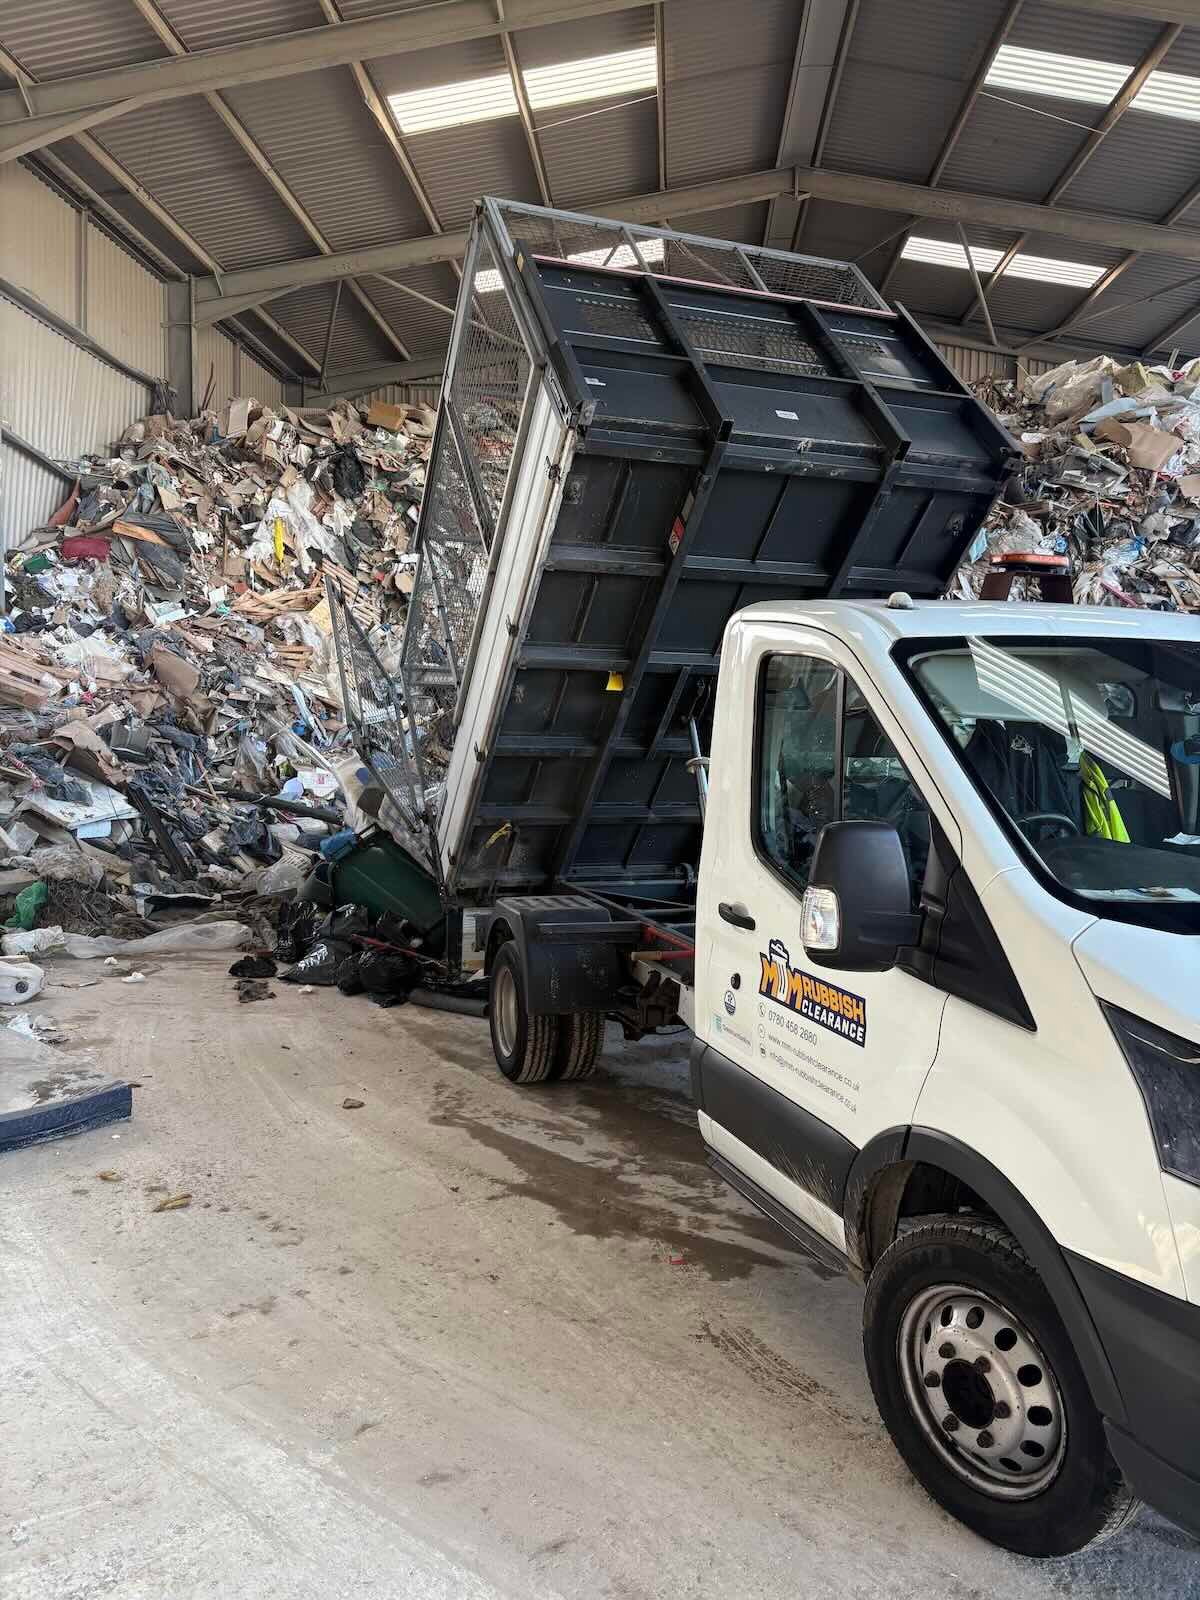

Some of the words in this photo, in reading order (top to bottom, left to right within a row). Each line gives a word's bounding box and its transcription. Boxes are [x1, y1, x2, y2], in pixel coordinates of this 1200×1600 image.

[801, 975, 864, 1025] RUBBISH
[801, 999, 864, 1043] CLEARANCE
[768, 1009, 784, 1028] 0780
[799, 1026, 818, 1047] 2680
